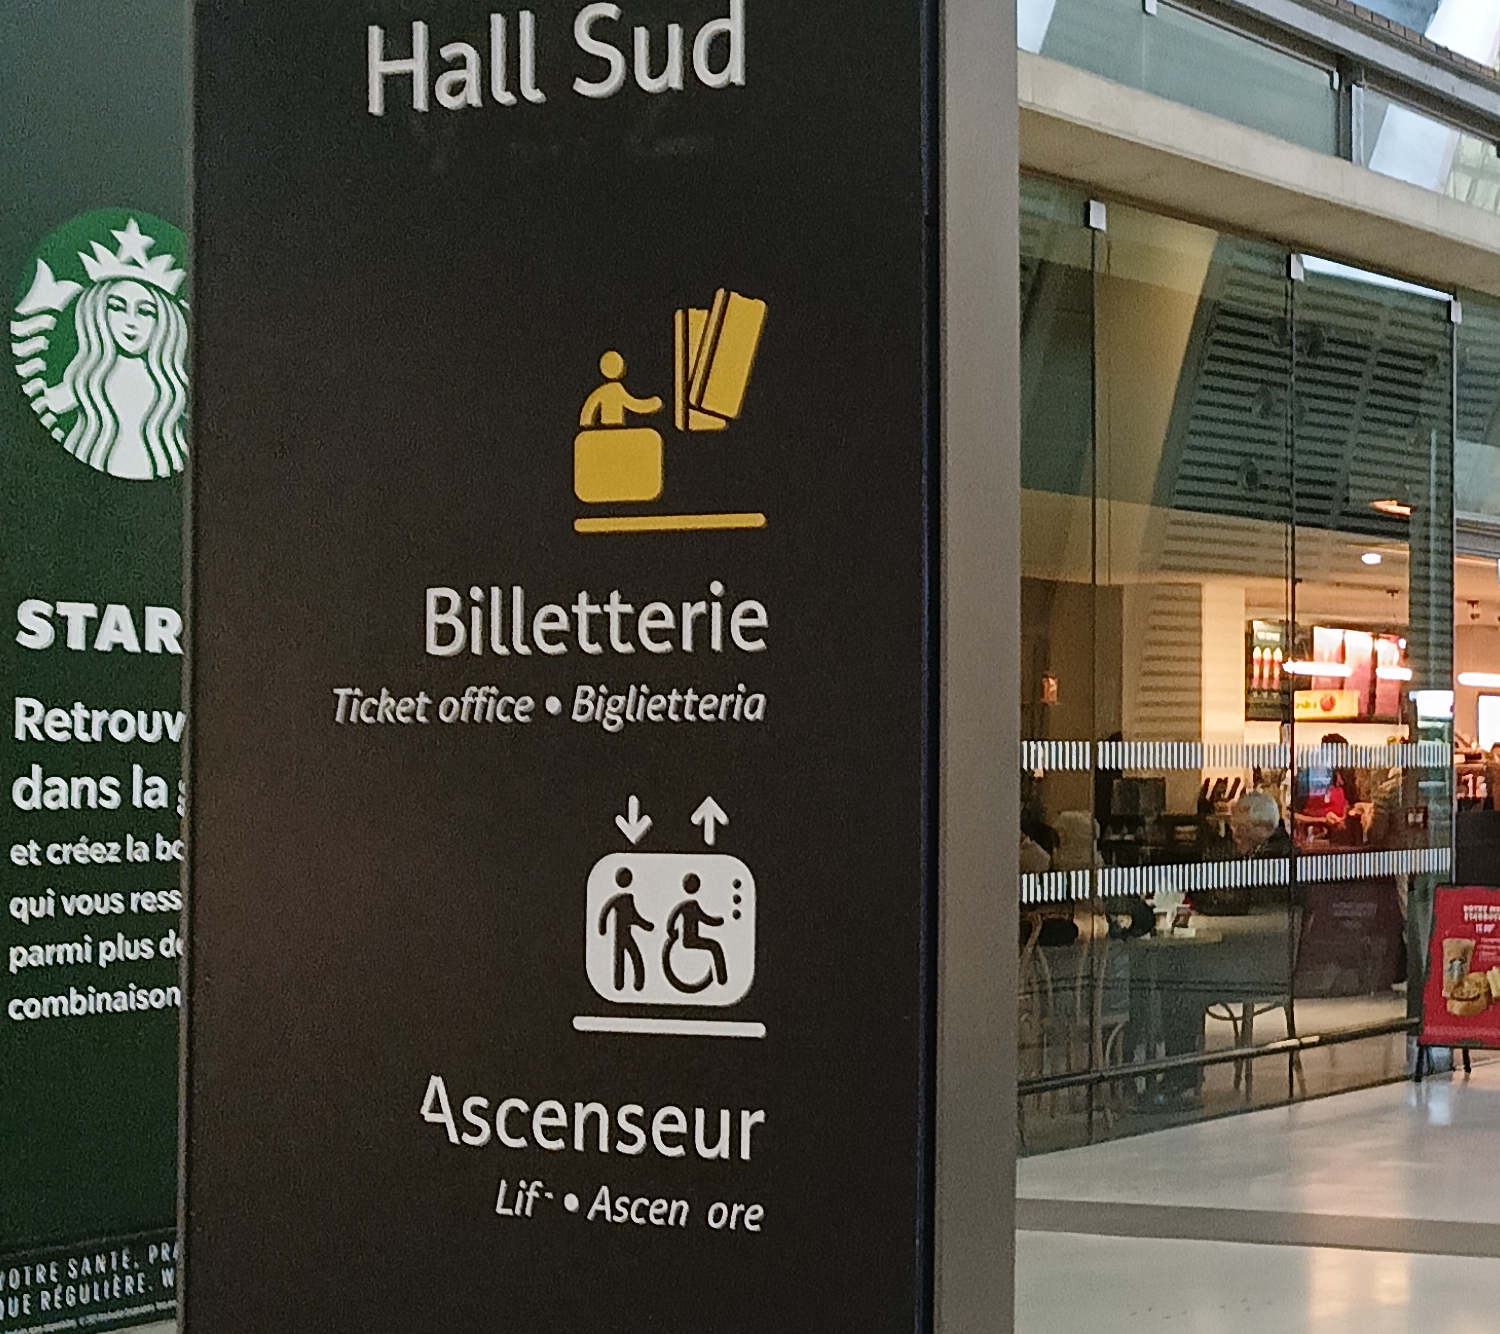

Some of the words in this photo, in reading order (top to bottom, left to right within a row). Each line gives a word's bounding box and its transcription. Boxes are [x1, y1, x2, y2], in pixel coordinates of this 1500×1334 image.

[368, 9, 547, 117] Hall
[425, 580, 770, 658] Billetterie
[333, 687, 433, 725] Ticket
[438, 685, 535, 724] office
[571, 683, 768, 734] Biglietteria
[11, 763, 122, 811] dans
[132, 763, 169, 809] la
[10, 839, 42, 866] et
[46, 834, 121, 865] créez
[126, 833, 150, 863] la
[9, 887, 56, 925] qui
[61, 892, 125, 916] vous
[9, 934, 93, 975] parmi
[98, 932, 155, 968] plus
[8, 983, 182, 1021] combinaison
[420, 1075, 766, 1161] Ascenseur
[496, 1179, 554, 1218] Lif
[586, 1185, 765, 1232] Ascenore
